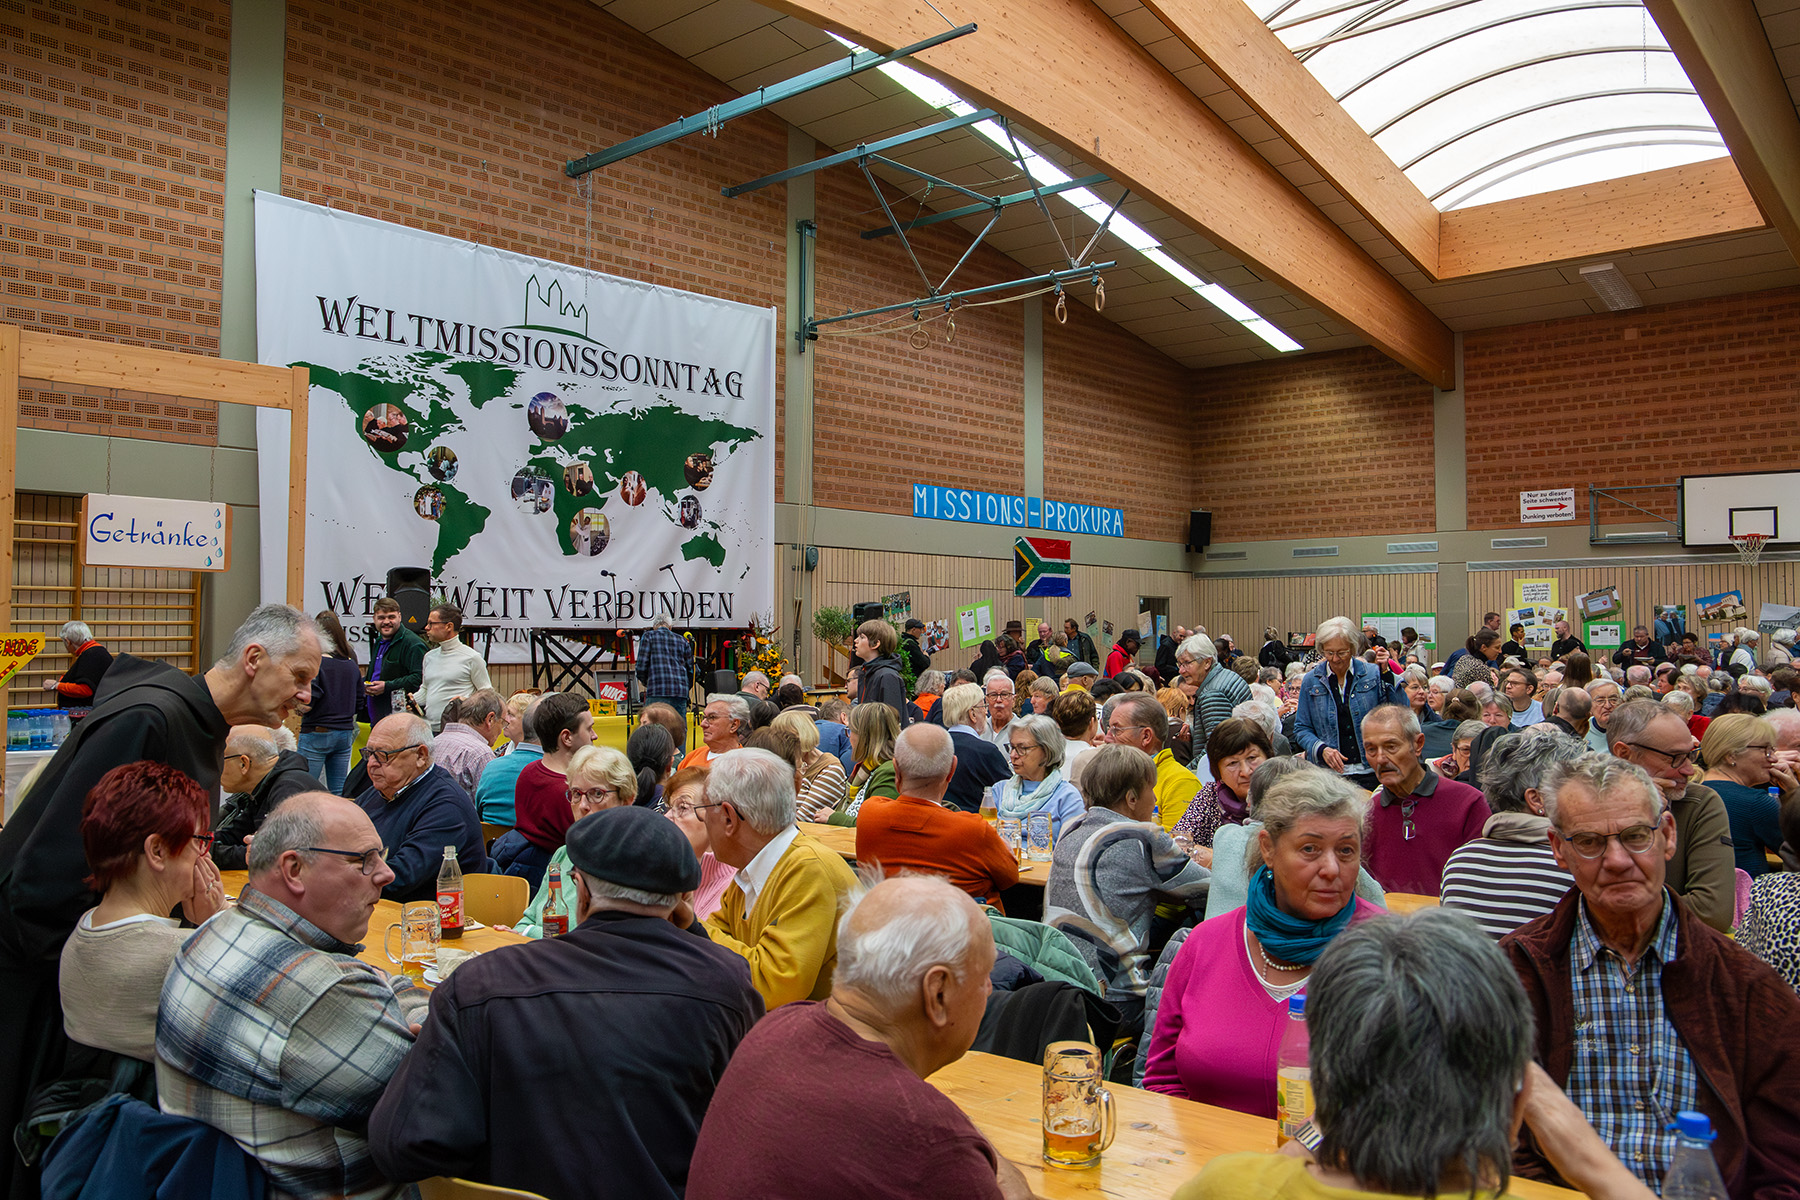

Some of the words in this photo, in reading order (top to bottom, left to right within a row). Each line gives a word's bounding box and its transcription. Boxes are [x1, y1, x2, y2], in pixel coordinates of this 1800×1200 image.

[316, 295, 745, 399] WELTMISSIONSSONNTAG
[89, 512, 208, 548] Getränke
[320, 573, 535, 620] WEWEIT
[543, 583, 735, 623] VERBUNDEN
[600, 684, 627, 701] NIKE
